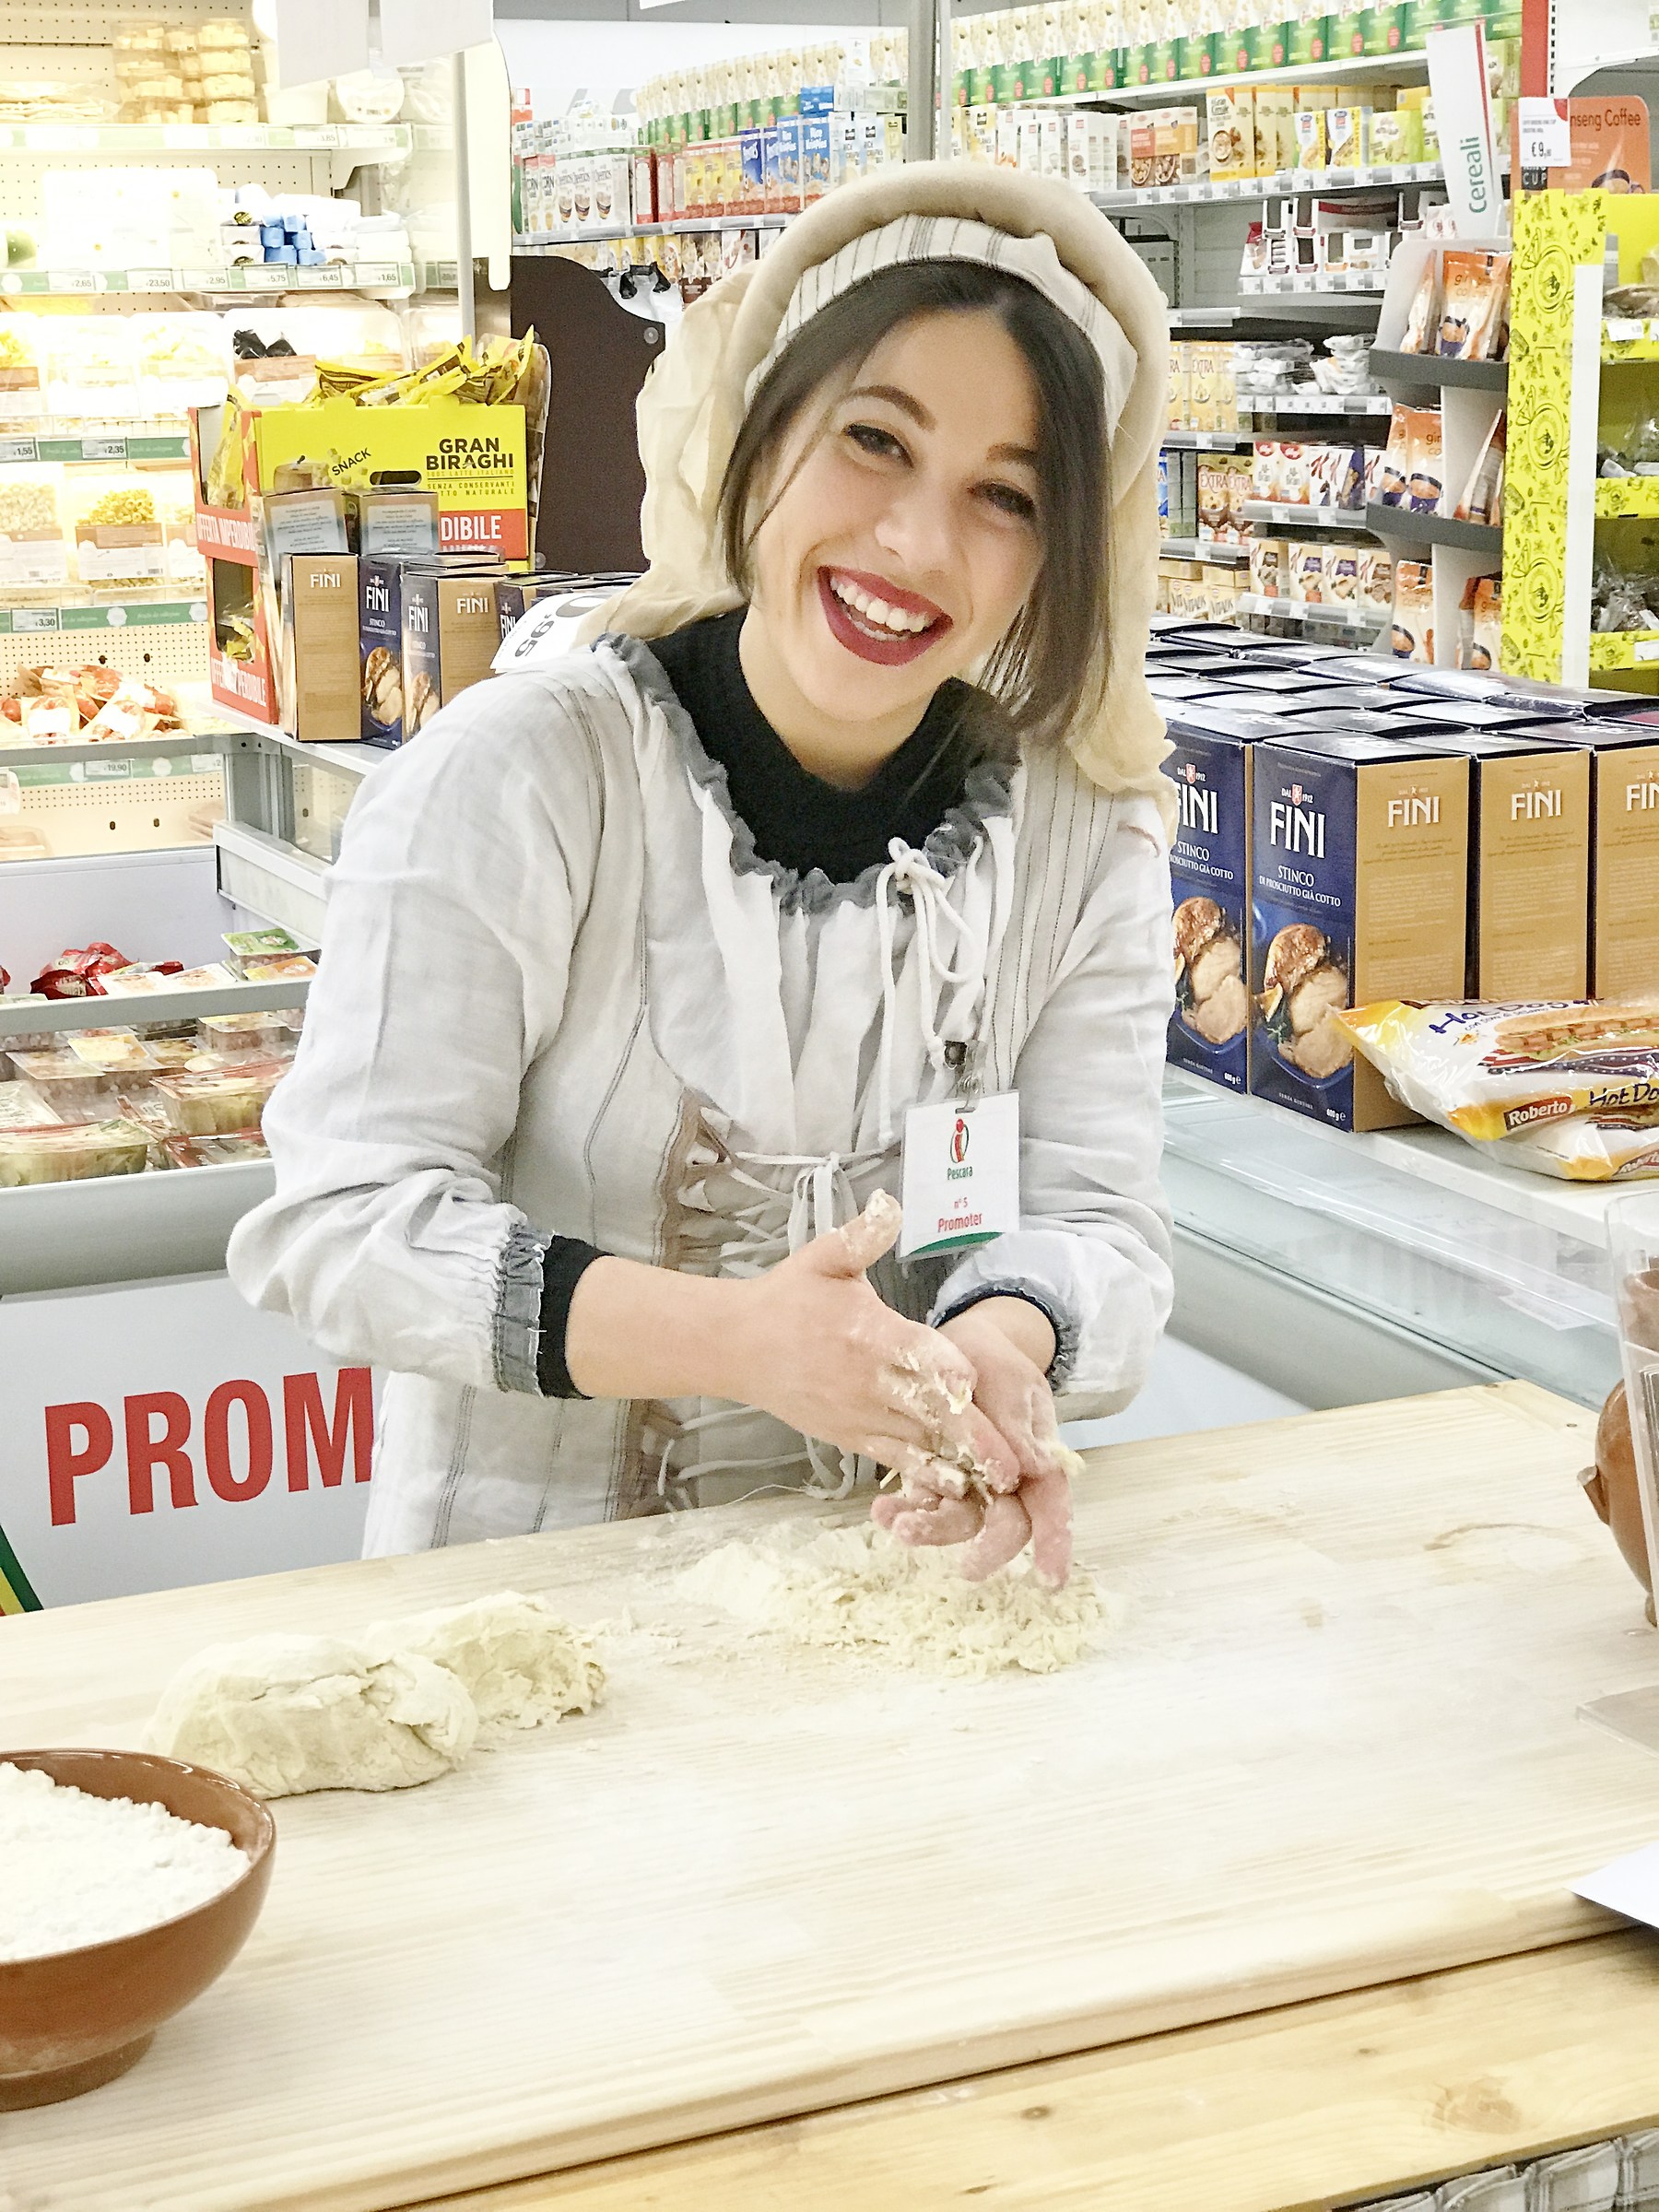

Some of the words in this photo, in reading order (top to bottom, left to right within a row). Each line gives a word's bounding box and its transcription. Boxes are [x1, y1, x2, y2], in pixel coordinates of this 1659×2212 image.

[1571, 112, 1602, 131] nseng
[1605, 109, 1641, 127] Coffee
[1523, 172, 1547, 185] CUP
[439, 437, 500, 454] GRAN
[332, 447, 372, 476] SNACK
[426, 453, 513, 470] BIRAGHI
[477, 468, 514, 477] ITALIANO
[459, 481, 515, 489] CONSERVANTI
[465, 488, 515, 496] NATURALE
[1200, 474, 1229, 493] EXTRA
[441, 514, 502, 542] DIBILE
[310, 573, 341, 589] FINI
[366, 585, 390, 612] FINI
[456, 597, 488, 614] FINI
[408, 606, 429, 633] FINI
[1281, 787, 1292, 798] DAL
[1301, 792, 1313, 803] 1912
[1512, 789, 1561, 820] FINI
[1627, 782, 1659, 811] FIN
[1388, 795, 1440, 828] FINI
[1270, 801, 1325, 859] FINI
[1177, 841, 1210, 862] STINCO
[1210, 866, 1234, 880] COTTO
[1277, 865, 1314, 887] STINCO
[1265, 877, 1301, 897] PROSCIUTTO
[1315, 893, 1341, 907] COTTO
[1509, 1100, 1567, 1126] Roberto
[1590, 1087, 1630, 1107] Hot
[1632, 1083, 1659, 1105] Do
[947, 1165, 973, 1181] Pescara
[937, 1212, 982, 1233] Promoter
[44, 1366, 374, 1526] PROM
